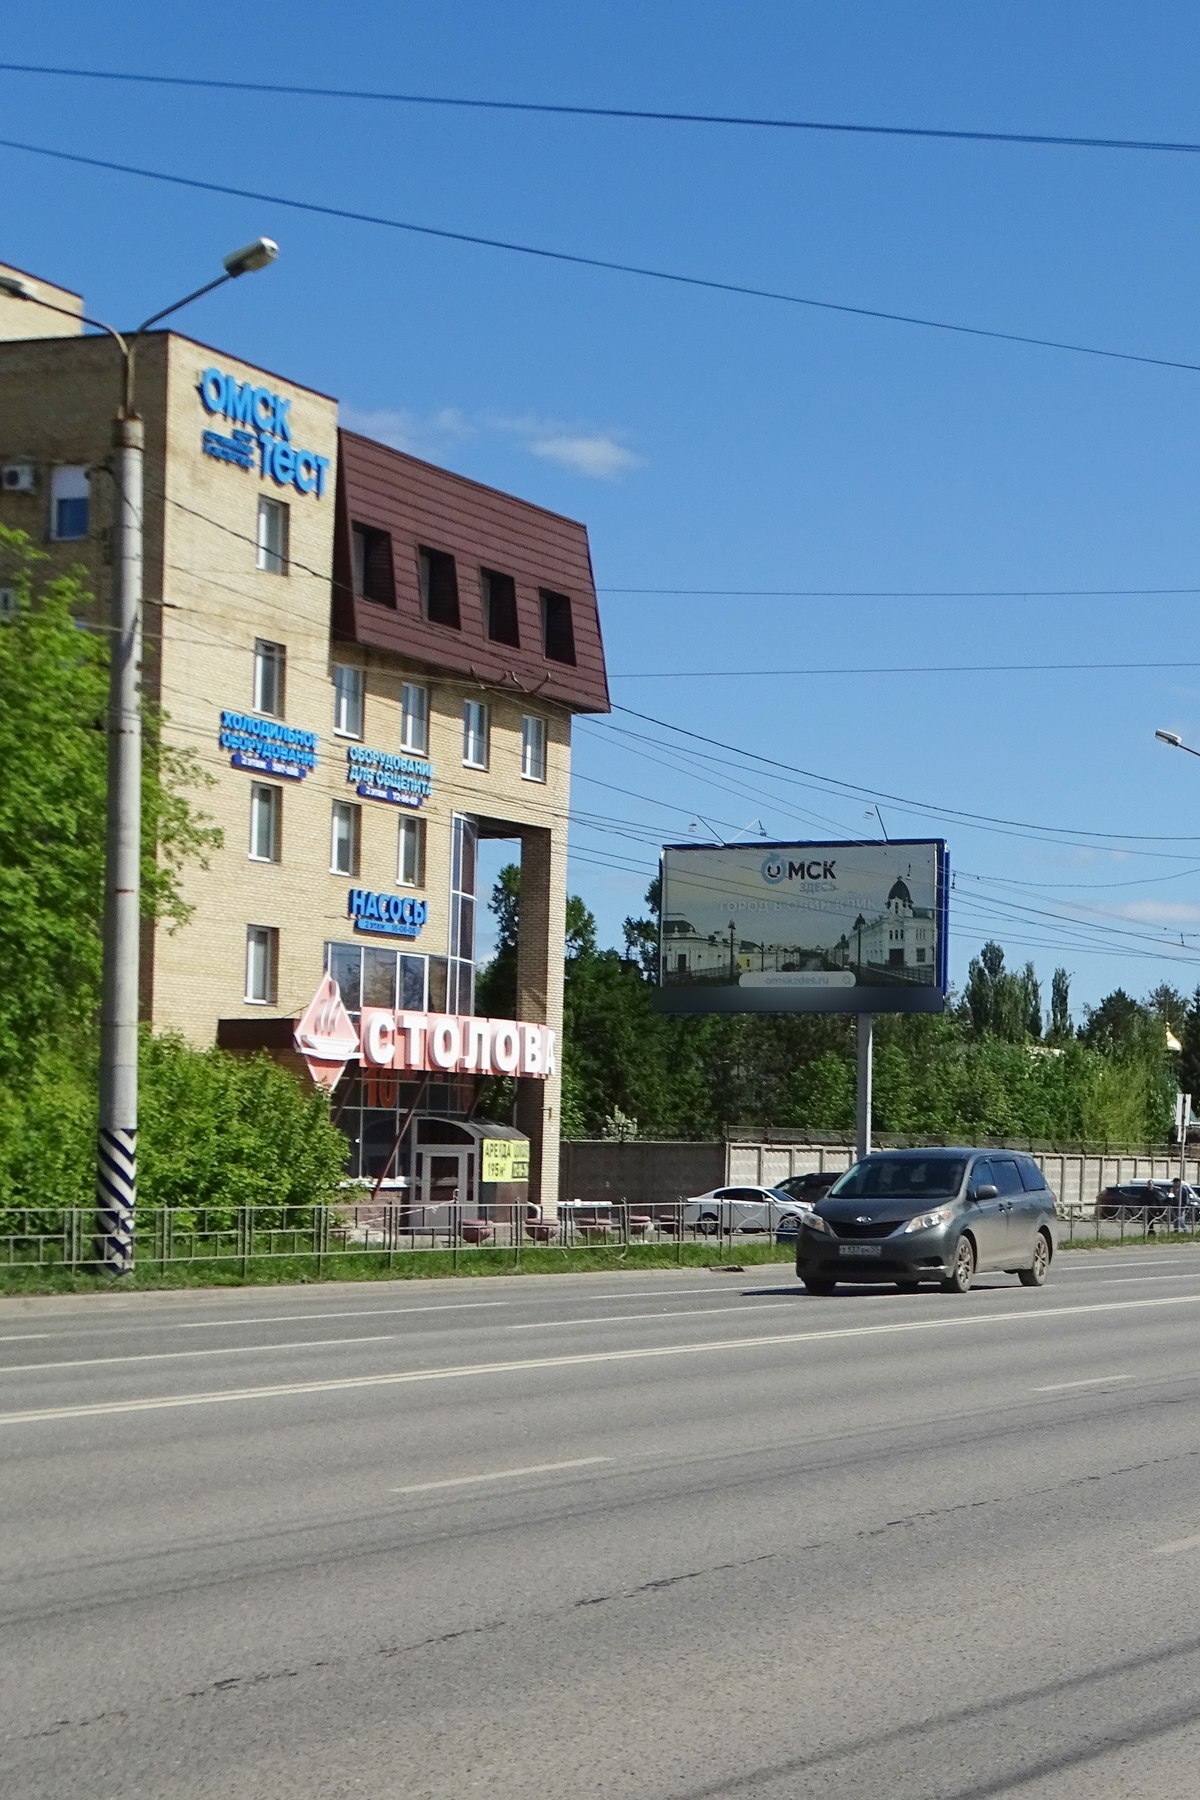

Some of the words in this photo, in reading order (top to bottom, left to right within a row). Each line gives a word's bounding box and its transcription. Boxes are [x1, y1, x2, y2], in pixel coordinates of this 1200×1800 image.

[202, 367, 292, 441] ОМСК
[348, 764, 375, 784] ДЛЯ
[375, 769, 433, 797] ОБЩЕПИТА
[351, 889, 429, 925] НАСОСЫ
